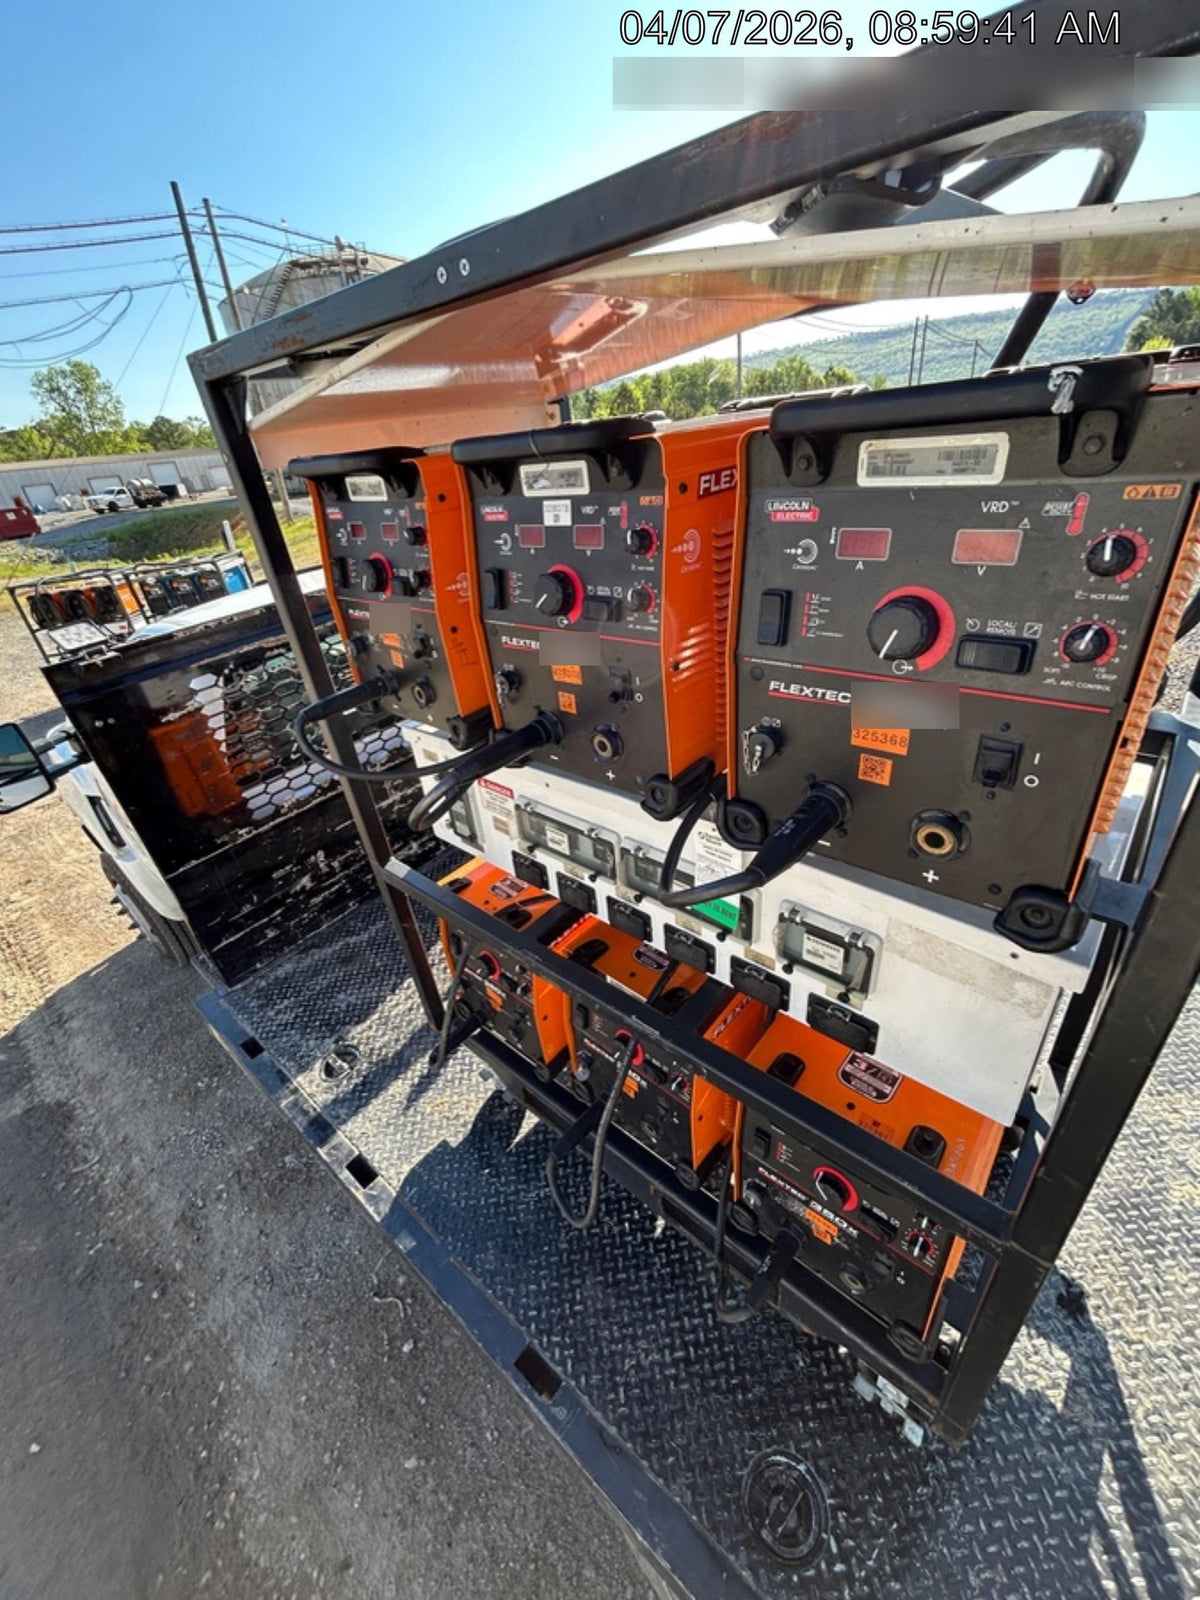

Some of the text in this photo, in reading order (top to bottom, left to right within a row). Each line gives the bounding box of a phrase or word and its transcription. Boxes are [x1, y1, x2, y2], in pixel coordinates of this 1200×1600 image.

[767, 501, 811, 511] LINCOLN
[976, 566, 987, 576] V
[769, 680, 851, 704] FLEXTEC
[852, 728, 908, 748] 325368
